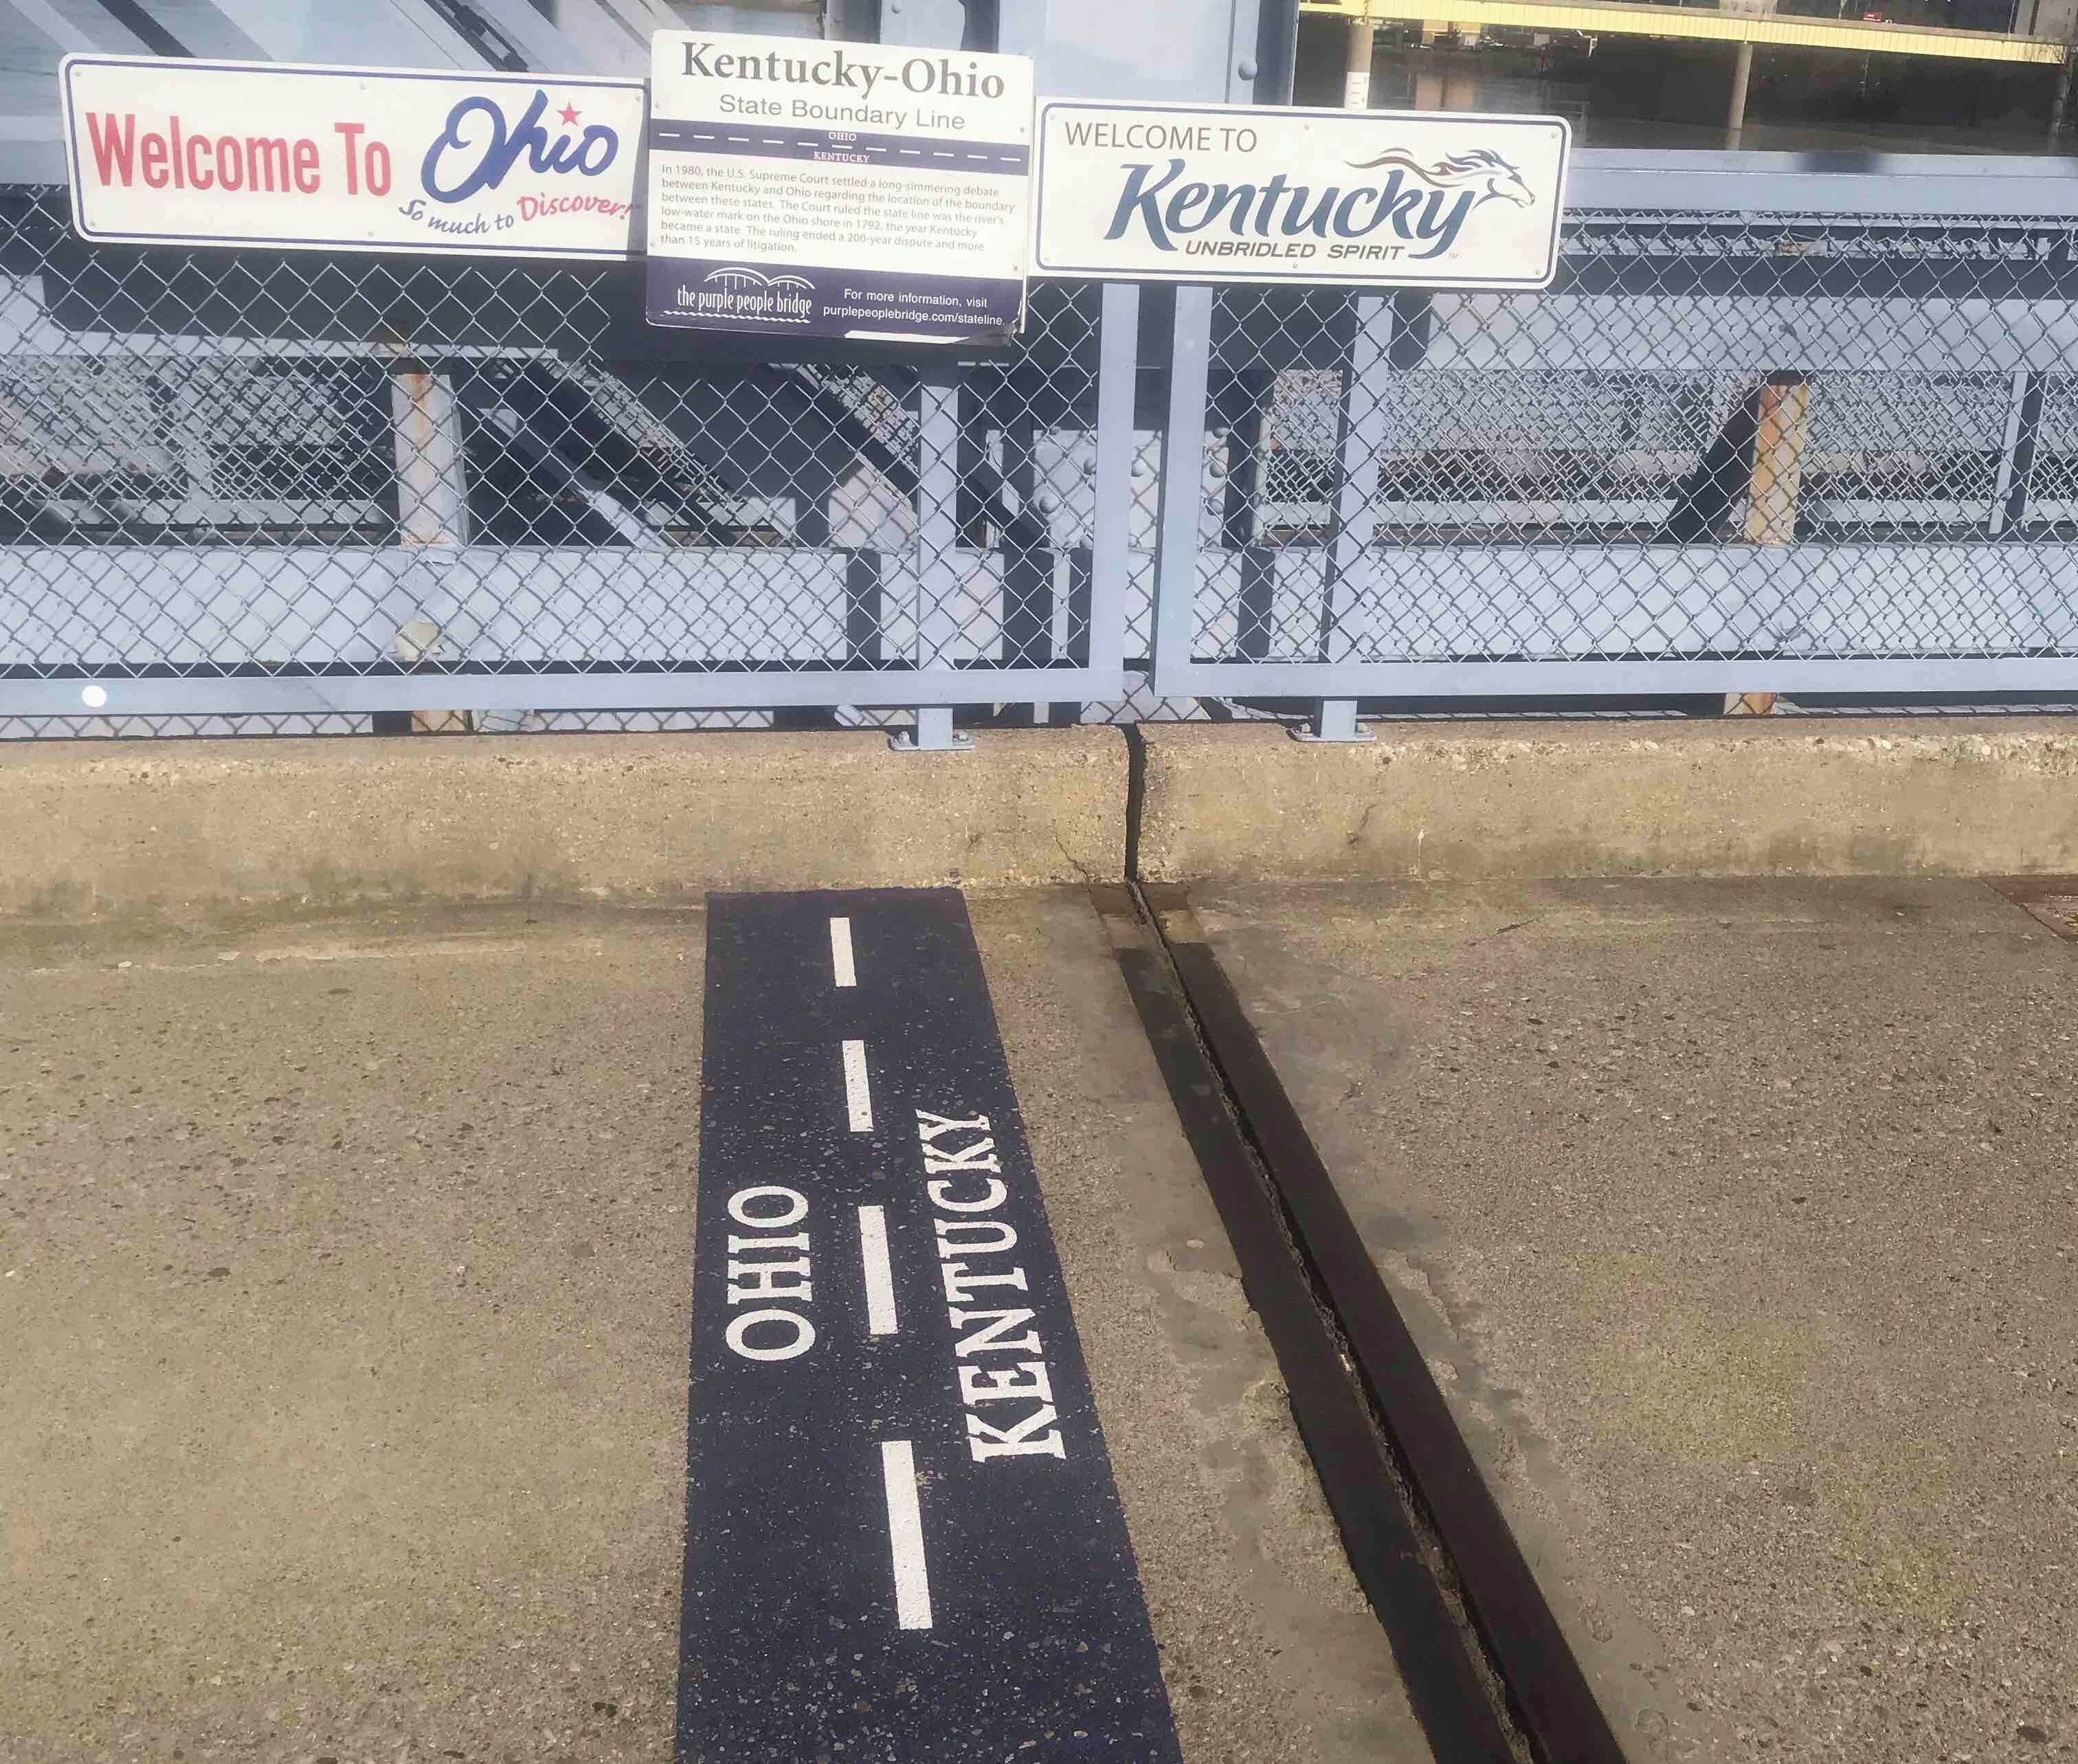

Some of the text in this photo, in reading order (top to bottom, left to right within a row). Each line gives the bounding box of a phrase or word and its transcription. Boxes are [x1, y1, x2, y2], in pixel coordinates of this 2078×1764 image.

[682, 42, 1005, 100] Kentucky-Ohio
[719, 94, 965, 130] State Boundary Line
[421, 89, 619, 203] Ohio
[829, 131, 857, 142] OHIO
[1064, 122, 1258, 153] WELCOME TO
[86, 113, 391, 197] Welcome To
[814, 150, 870, 164] KENTUCKY
[662, 166, 671, 174] In
[676, 166, 703, 177] 1980,
[706, 168, 724, 177] the
[727, 169, 745, 178] U.S.
[750, 170, 797, 182] Supreme
[799, 173, 829, 186] Court
[832, 177, 867, 188] settled
[963, 186, 999, 197] debate
[662, 179, 1016, 214] between Kentucky and Ohio regarding the location of the boundary
[399, 192, 633, 234] So much to Discover!
[662, 192, 707, 203] between
[711, 195, 740, 206] these
[743, 198, 775, 209] states.
[780, 199, 798, 210] The
[801, 201, 831, 213] Court
[834, 204, 860, 214] ruled
[864, 207, 880, 216] the
[883, 208, 908, 218] state
[911, 209, 929, 219] line
[933, 213, 952, 221] was
[955, 212, 972, 223] the
[662, 207, 713, 219] low-water
[717, 210, 744, 221] mark
[763, 212, 780, 223] the
[783, 214, 808, 225] Ohio
[812, 216, 840, 227] shore
[843, 219, 852, 228] in
[856, 219, 883, 232] 1792,
[886, 221, 902, 231] the
[906, 224, 928, 235] year
[930, 225, 978, 238] Kentucky
[1103, 158, 1477, 260] Kentucky
[660, 234, 797, 254] than 15 years of litigation.
[661, 220, 703, 232] became
[746, 225, 766, 236] The
[769, 227, 800, 240] ruling
[803, 230, 836, 241] ended
[894, 236, 932, 250] dispute
[935, 239, 954, 249] and
[957, 242, 984, 252] more
[1185, 241, 1316, 259] UNBRIDLED
[1327, 243, 1405, 260] SPIRIT
[677, 284, 812, 318] the purple people bridge
[845, 289, 988, 309] For more information, visit
[726, 1185, 816, 1361] OHIO
[915, 1109, 1066, 1462] KENTUCKY
